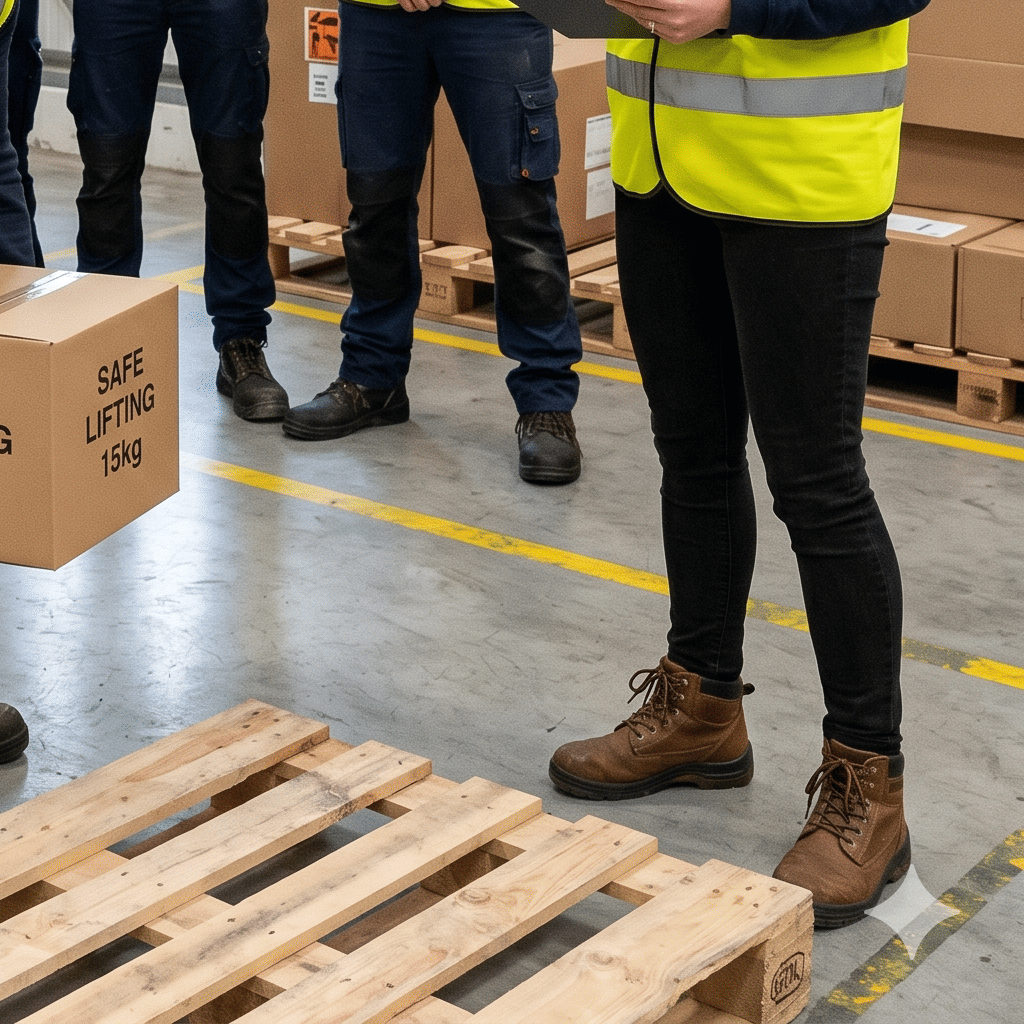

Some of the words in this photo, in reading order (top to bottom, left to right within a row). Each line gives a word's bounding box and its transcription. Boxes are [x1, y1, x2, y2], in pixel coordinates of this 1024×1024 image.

[97, 346, 144, 395] SAFE
[86, 383, 155, 445] LIFTING
[101, 437, 142, 477] 15kg
